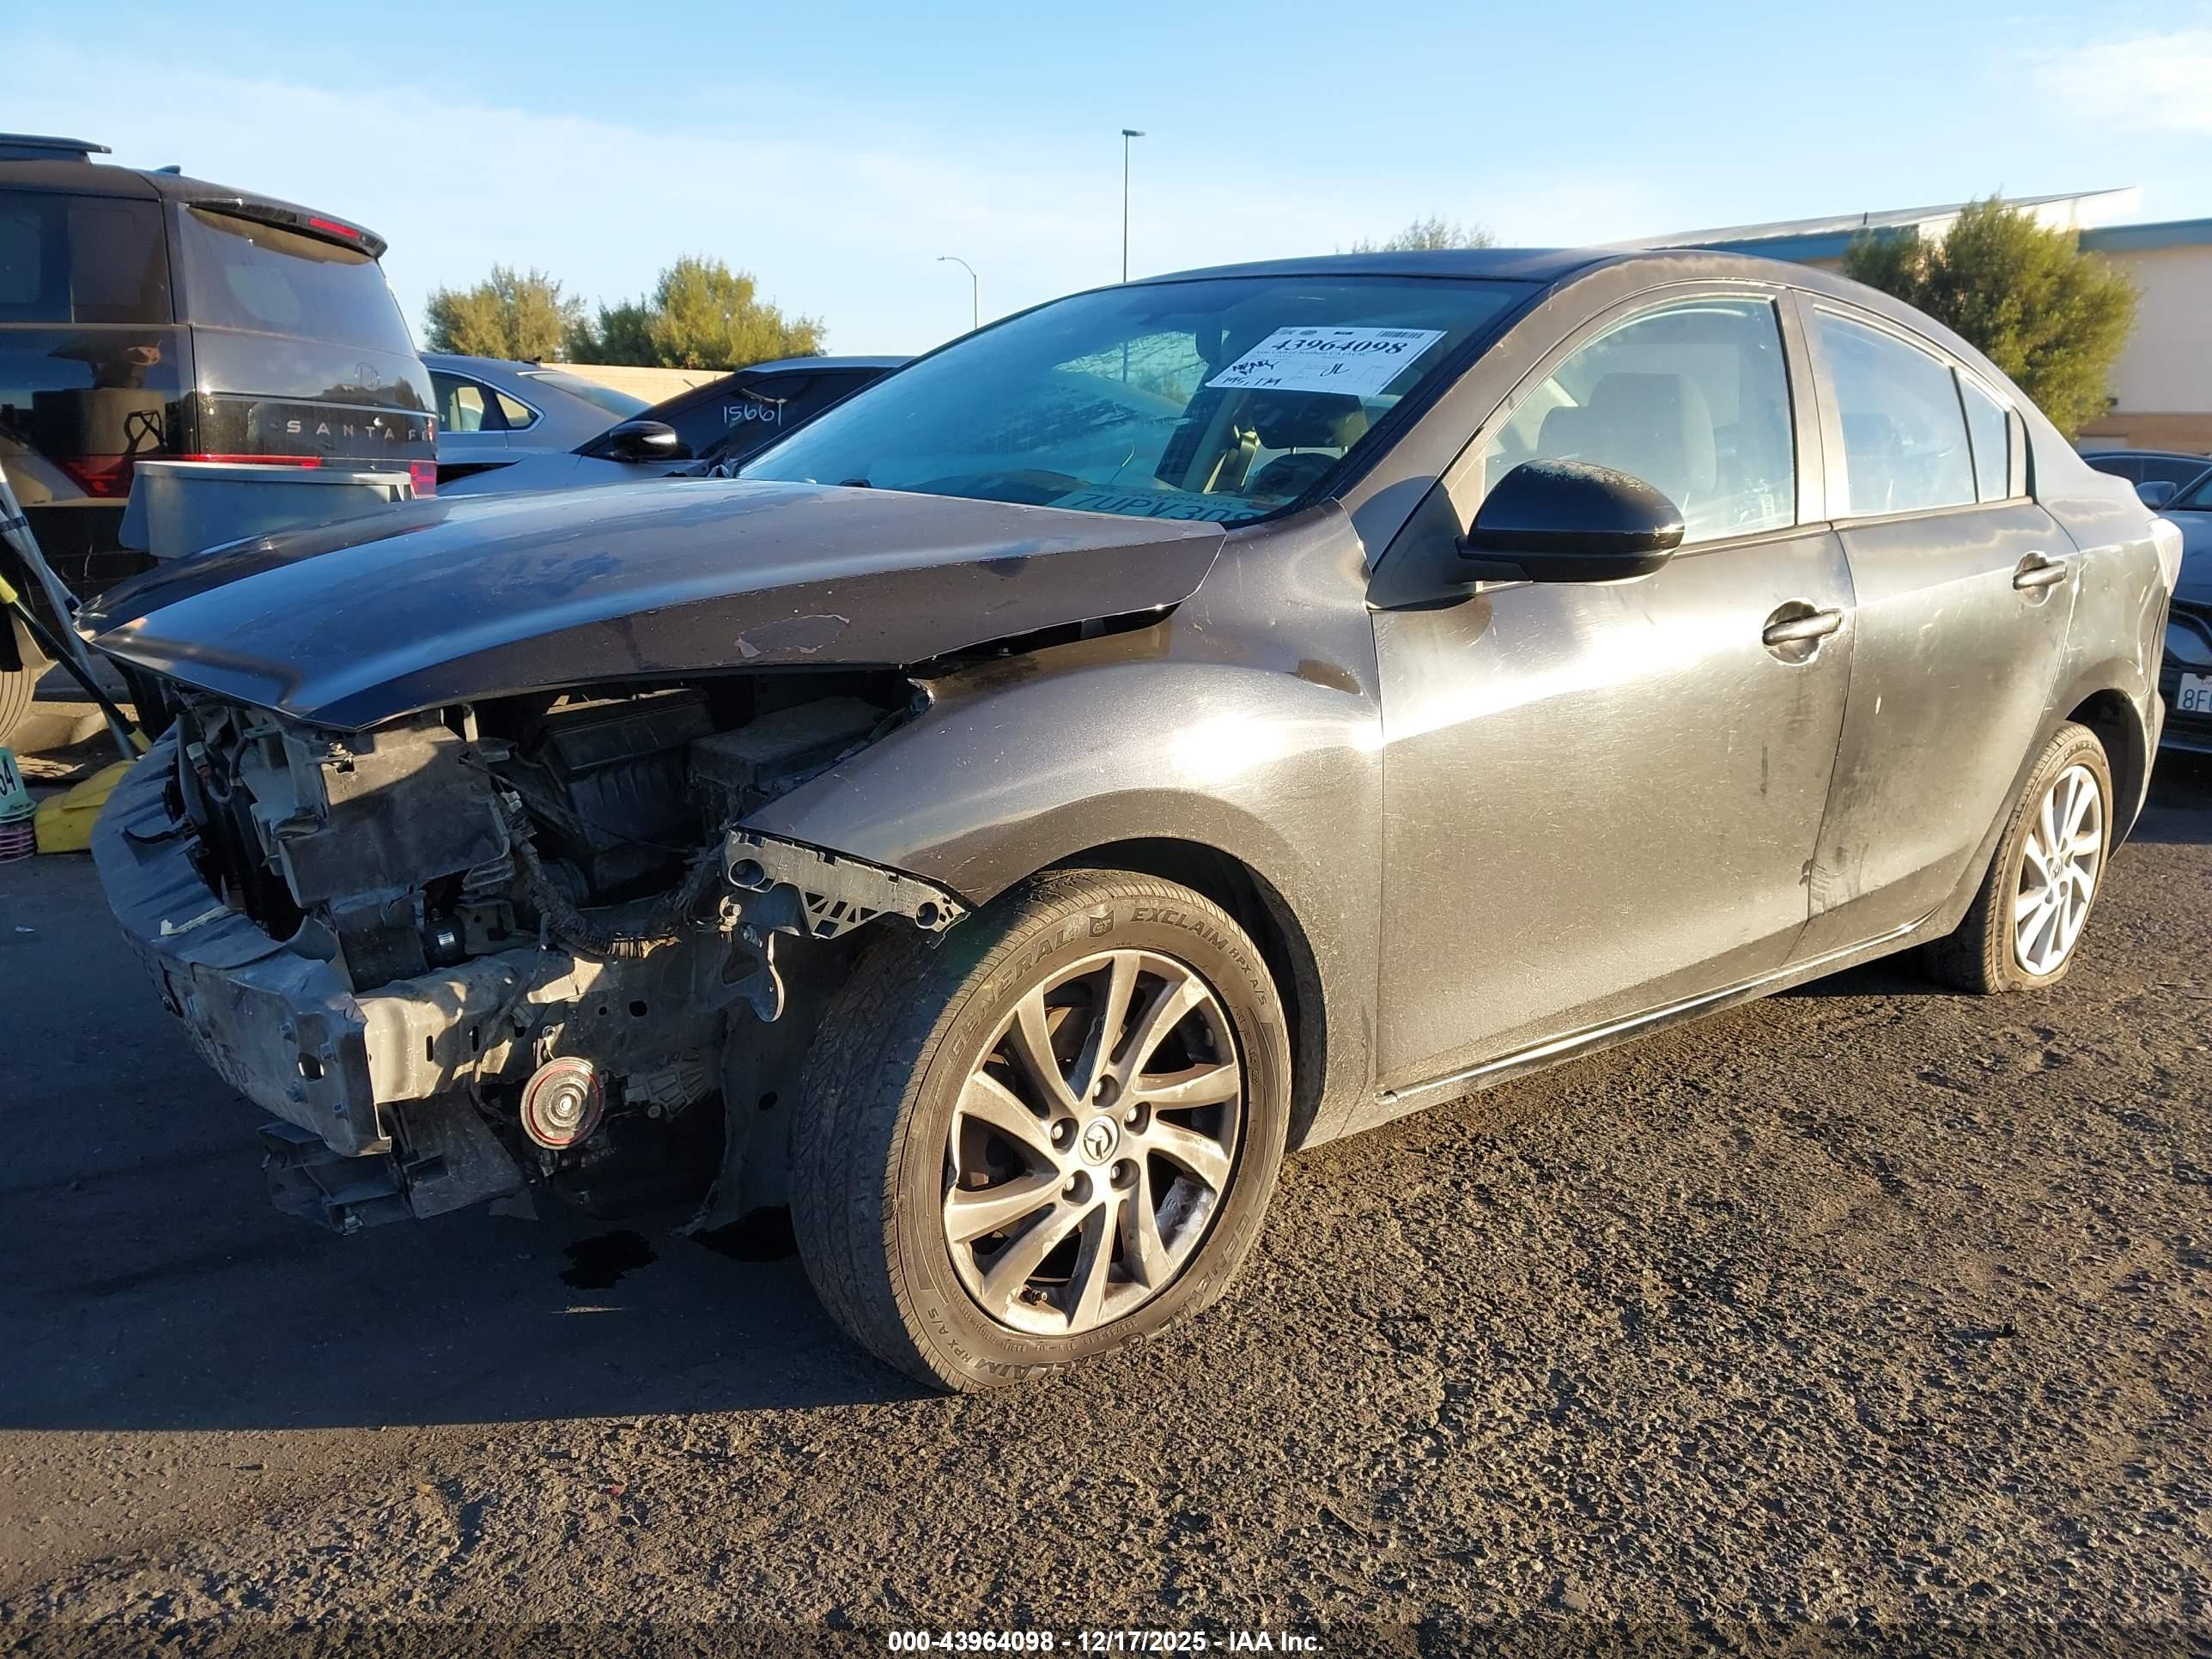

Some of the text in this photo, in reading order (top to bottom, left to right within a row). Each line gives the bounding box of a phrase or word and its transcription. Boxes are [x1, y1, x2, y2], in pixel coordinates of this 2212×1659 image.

[1272, 338, 1408, 355] 43964098
[287, 420, 395, 440] SANTA
[947, 930, 1075, 1061] GENERAL
[1130, 908, 1230, 951] EXCLAIM
[1229, 945, 1252, 975] HPX
[1249, 979, 1267, 1006] A/S
[946, 1337, 973, 1364] HPX
